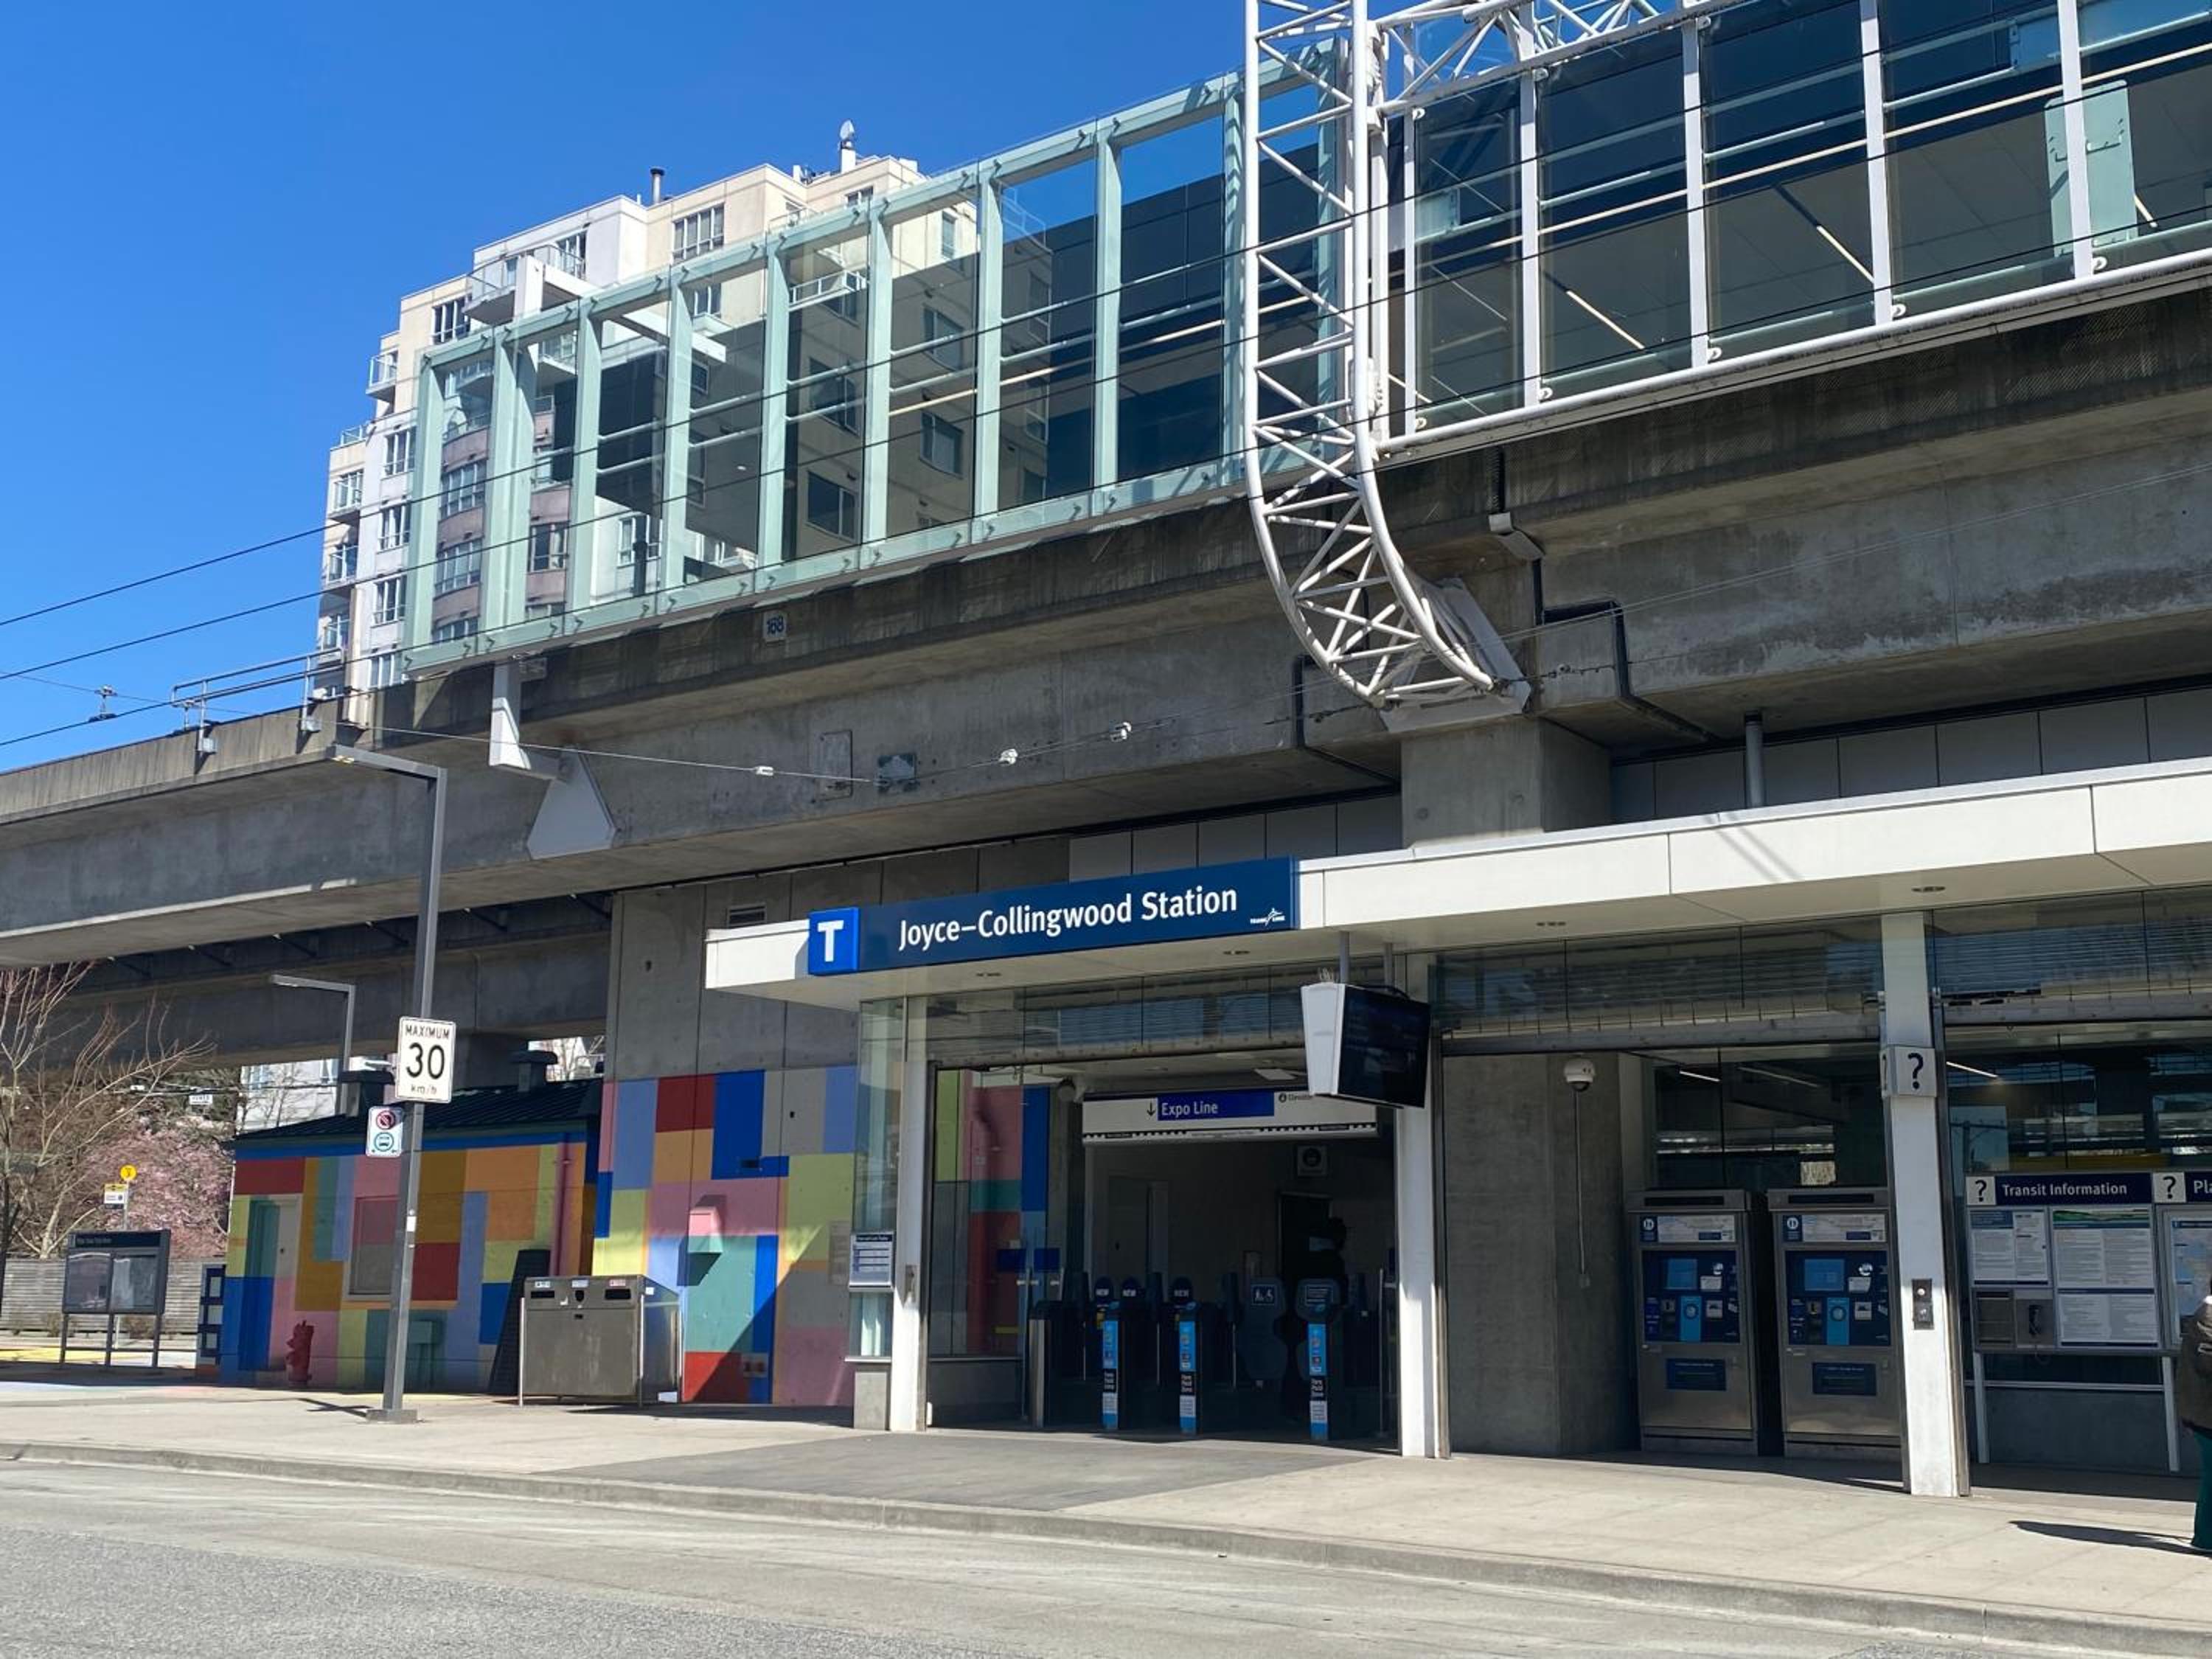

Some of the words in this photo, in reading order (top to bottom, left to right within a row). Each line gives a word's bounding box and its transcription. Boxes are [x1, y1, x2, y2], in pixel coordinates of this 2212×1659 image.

[1141, 885, 1238, 921] Station
[817, 919, 845, 962] T
[405, 1024, 450, 1040] MAXIMUM
[406, 1042, 445, 1080] 30
[411, 1084, 437, 1096] km/h
[1161, 1102, 1191, 1118] Expo
[1193, 1100, 1219, 1116] Line
[2002, 1183, 2046, 1197] Transit
[2050, 1181, 2128, 1197] Information
